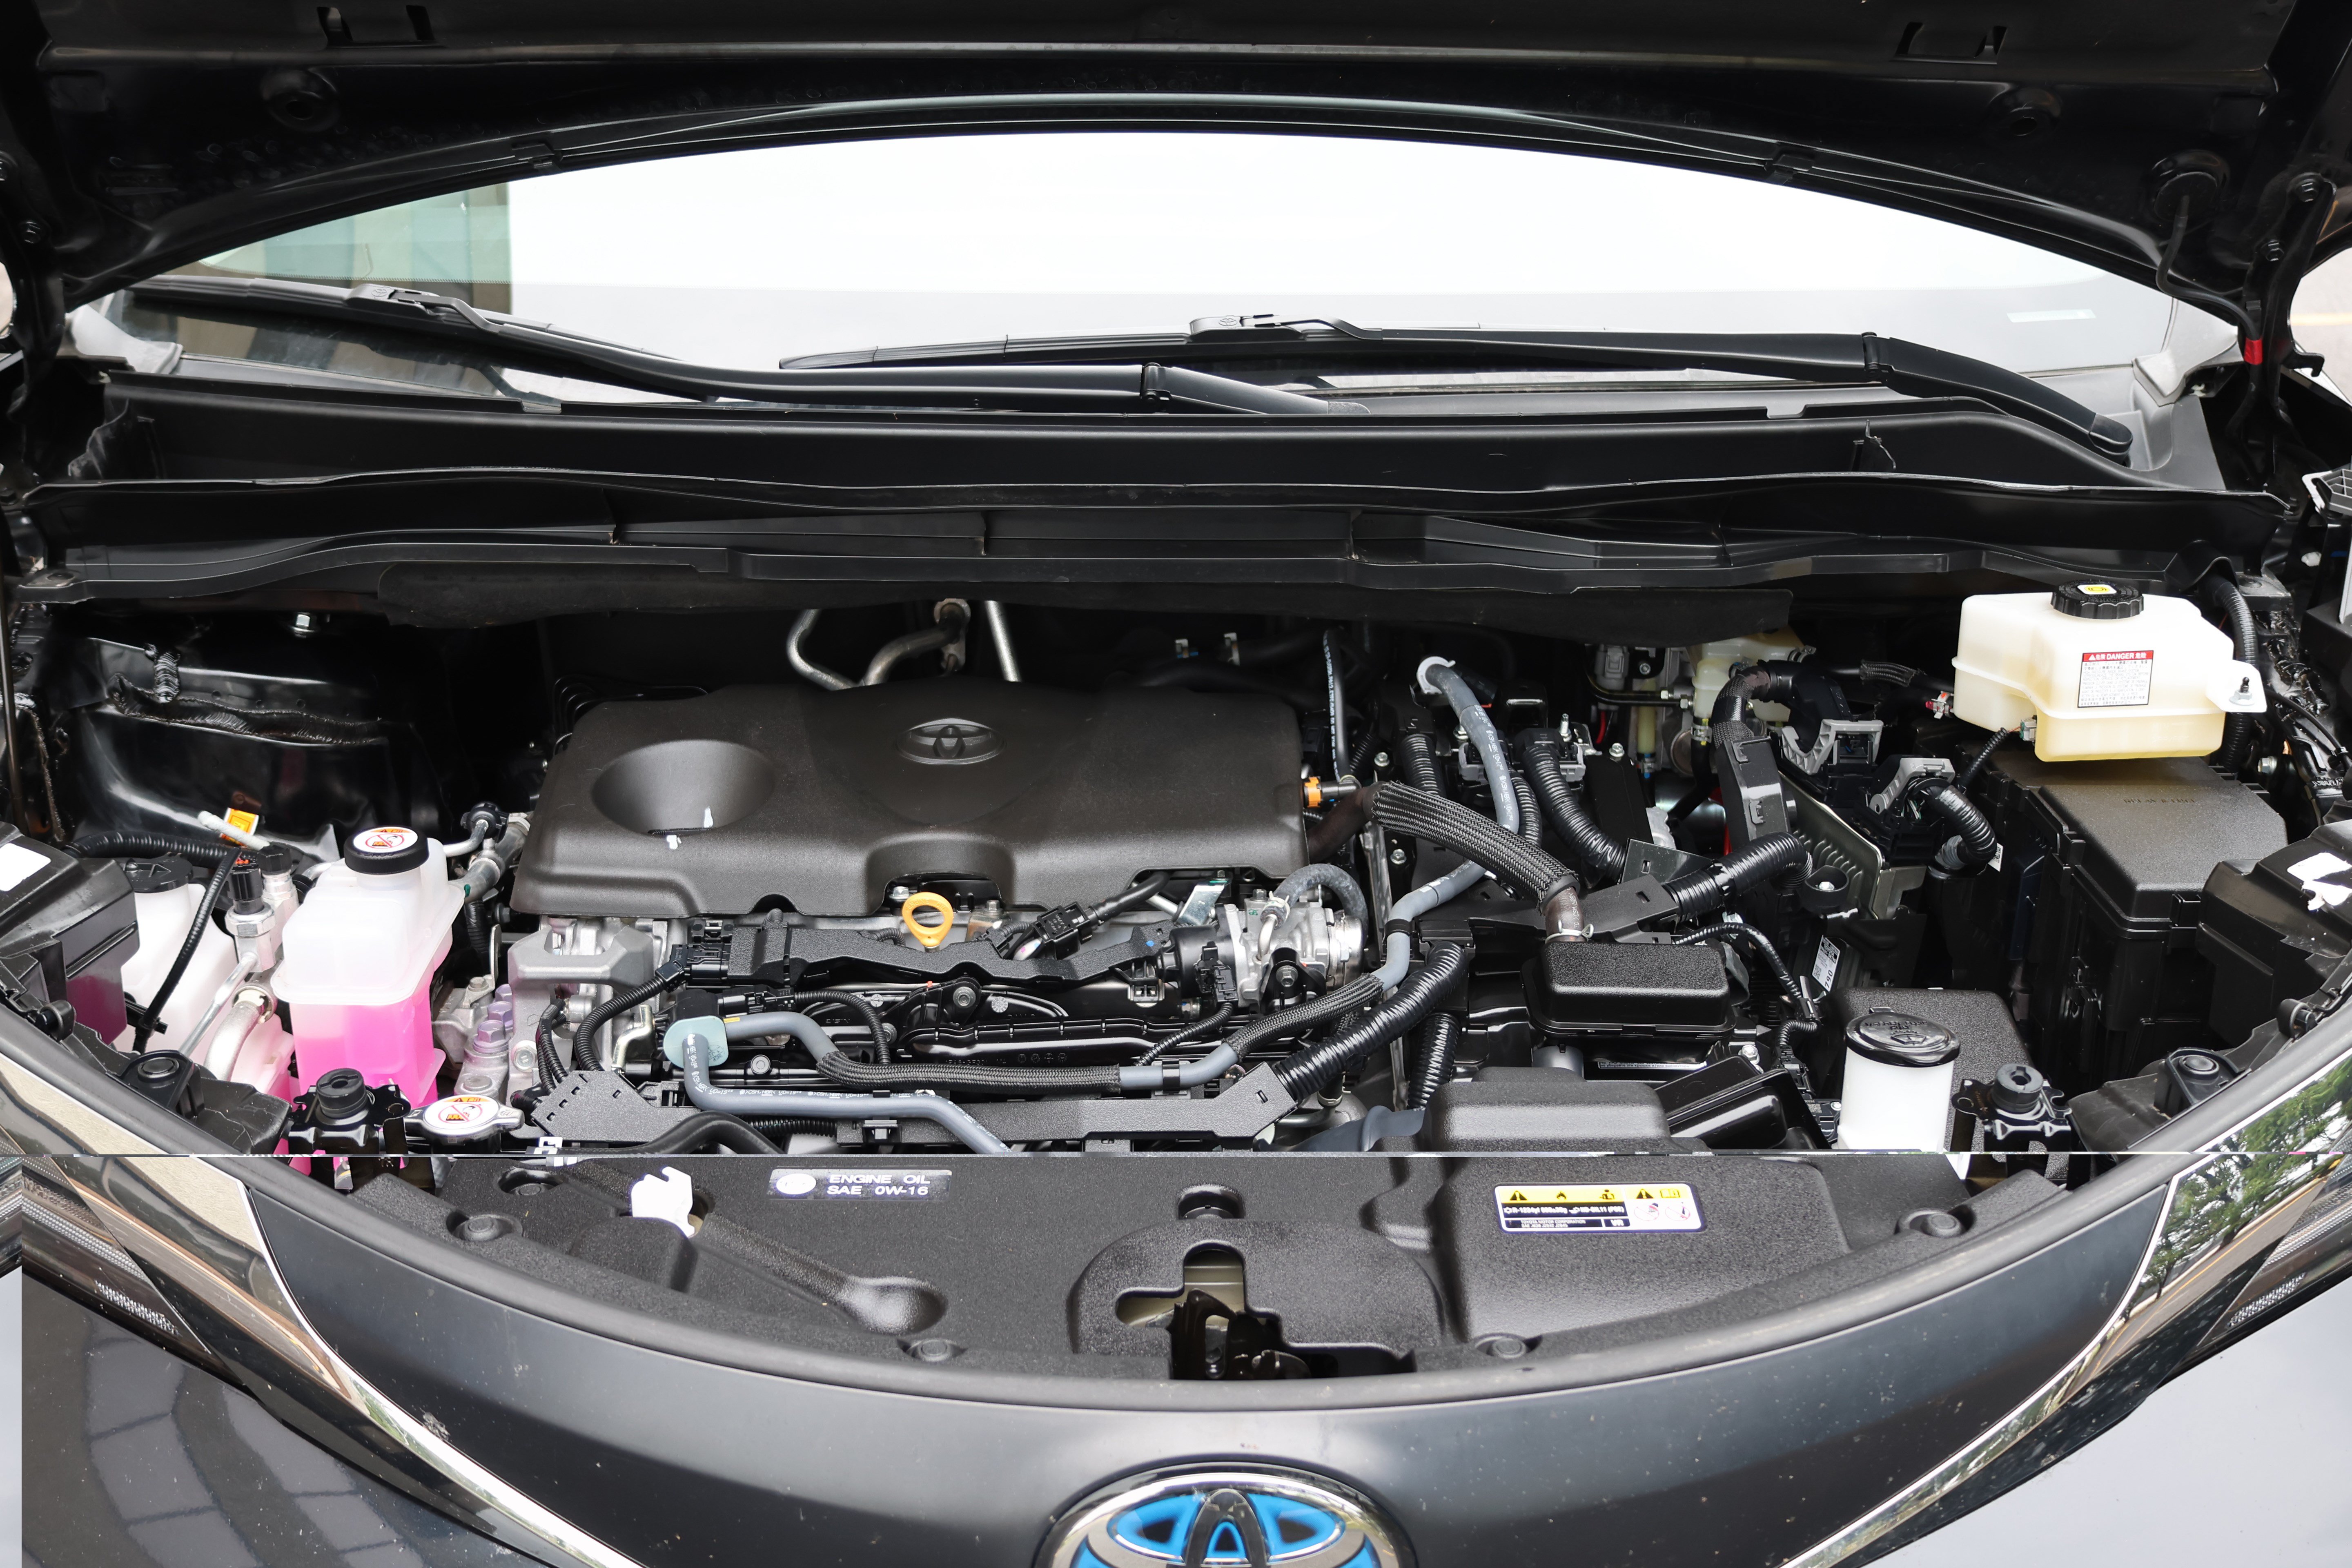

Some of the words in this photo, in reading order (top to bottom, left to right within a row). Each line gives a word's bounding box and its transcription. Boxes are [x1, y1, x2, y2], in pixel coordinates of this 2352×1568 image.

[1824, 970, 1833, 989] 790
[829, 1174, 893, 1184] ENGINE
[903, 1174, 931, 1184] OIL
[827, 1185, 862, 1195] SAE
[875, 1186, 929, 1196] 0W-16
